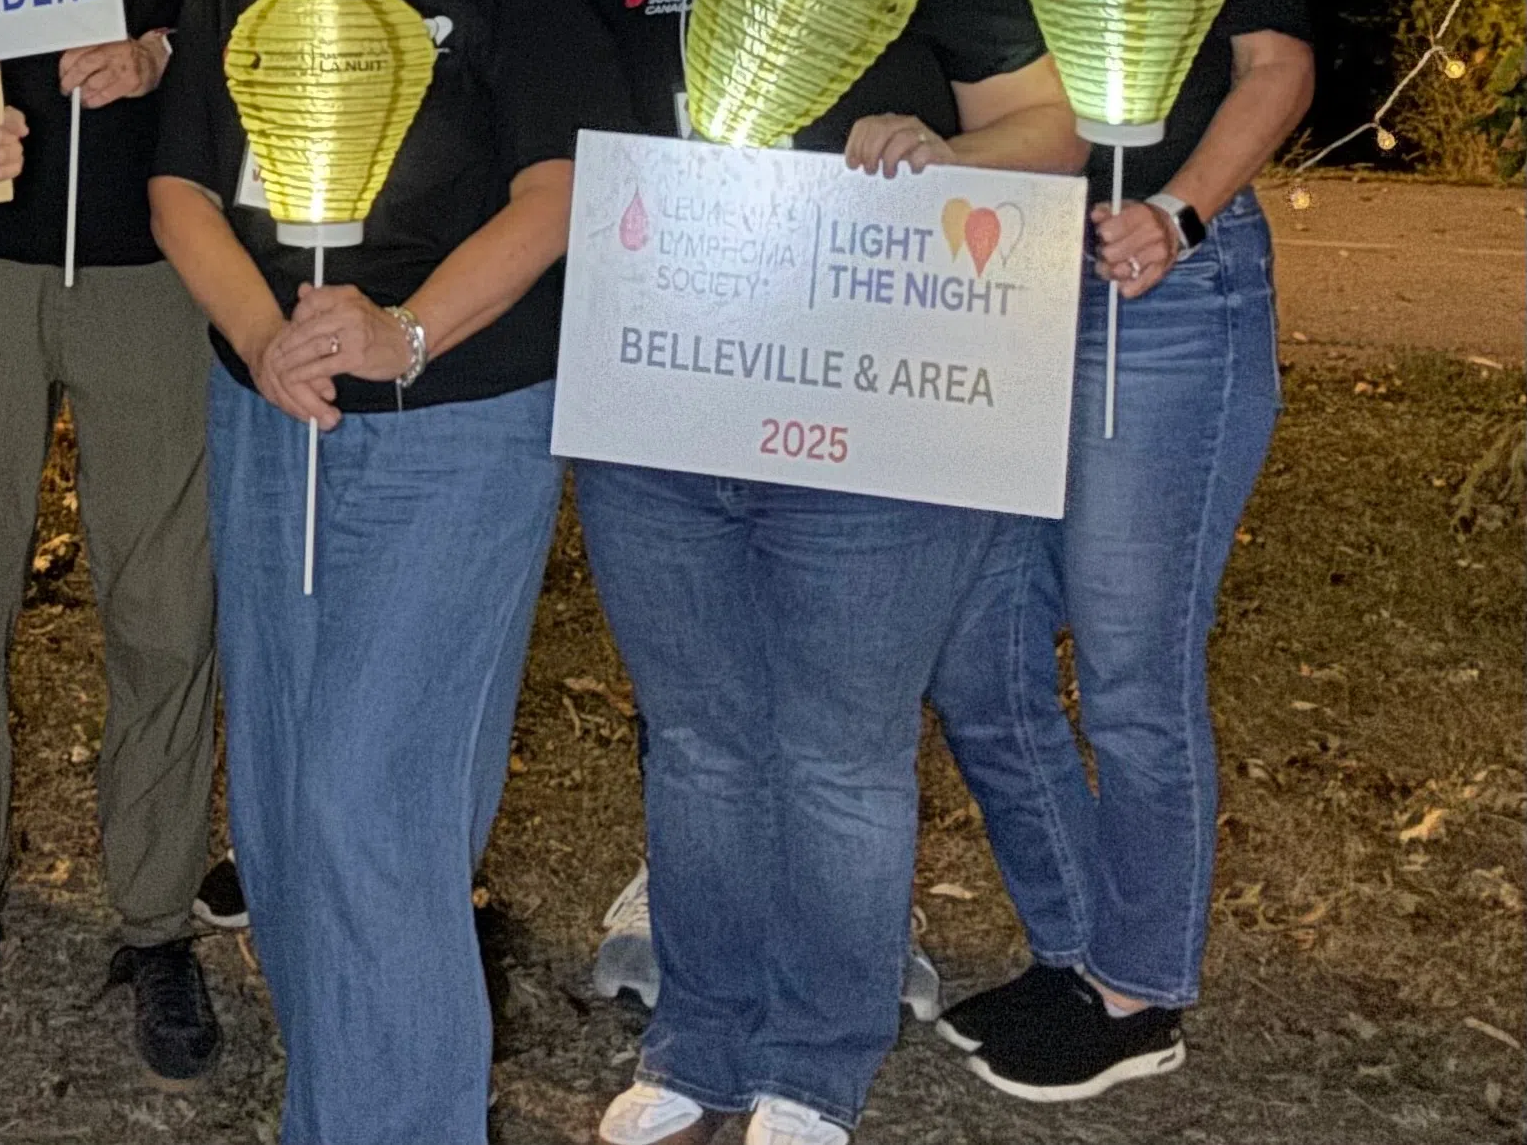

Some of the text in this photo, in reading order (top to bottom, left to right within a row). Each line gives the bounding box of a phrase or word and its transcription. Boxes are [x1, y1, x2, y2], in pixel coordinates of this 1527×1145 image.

[345, 59, 382, 72] NUIT
[829, 220, 934, 263] LIGHT
[828, 265, 1017, 316] THE NIGHT
[619, 326, 995, 407] BELLEVILLE & AREA
[760, 418, 849, 463] 2025
